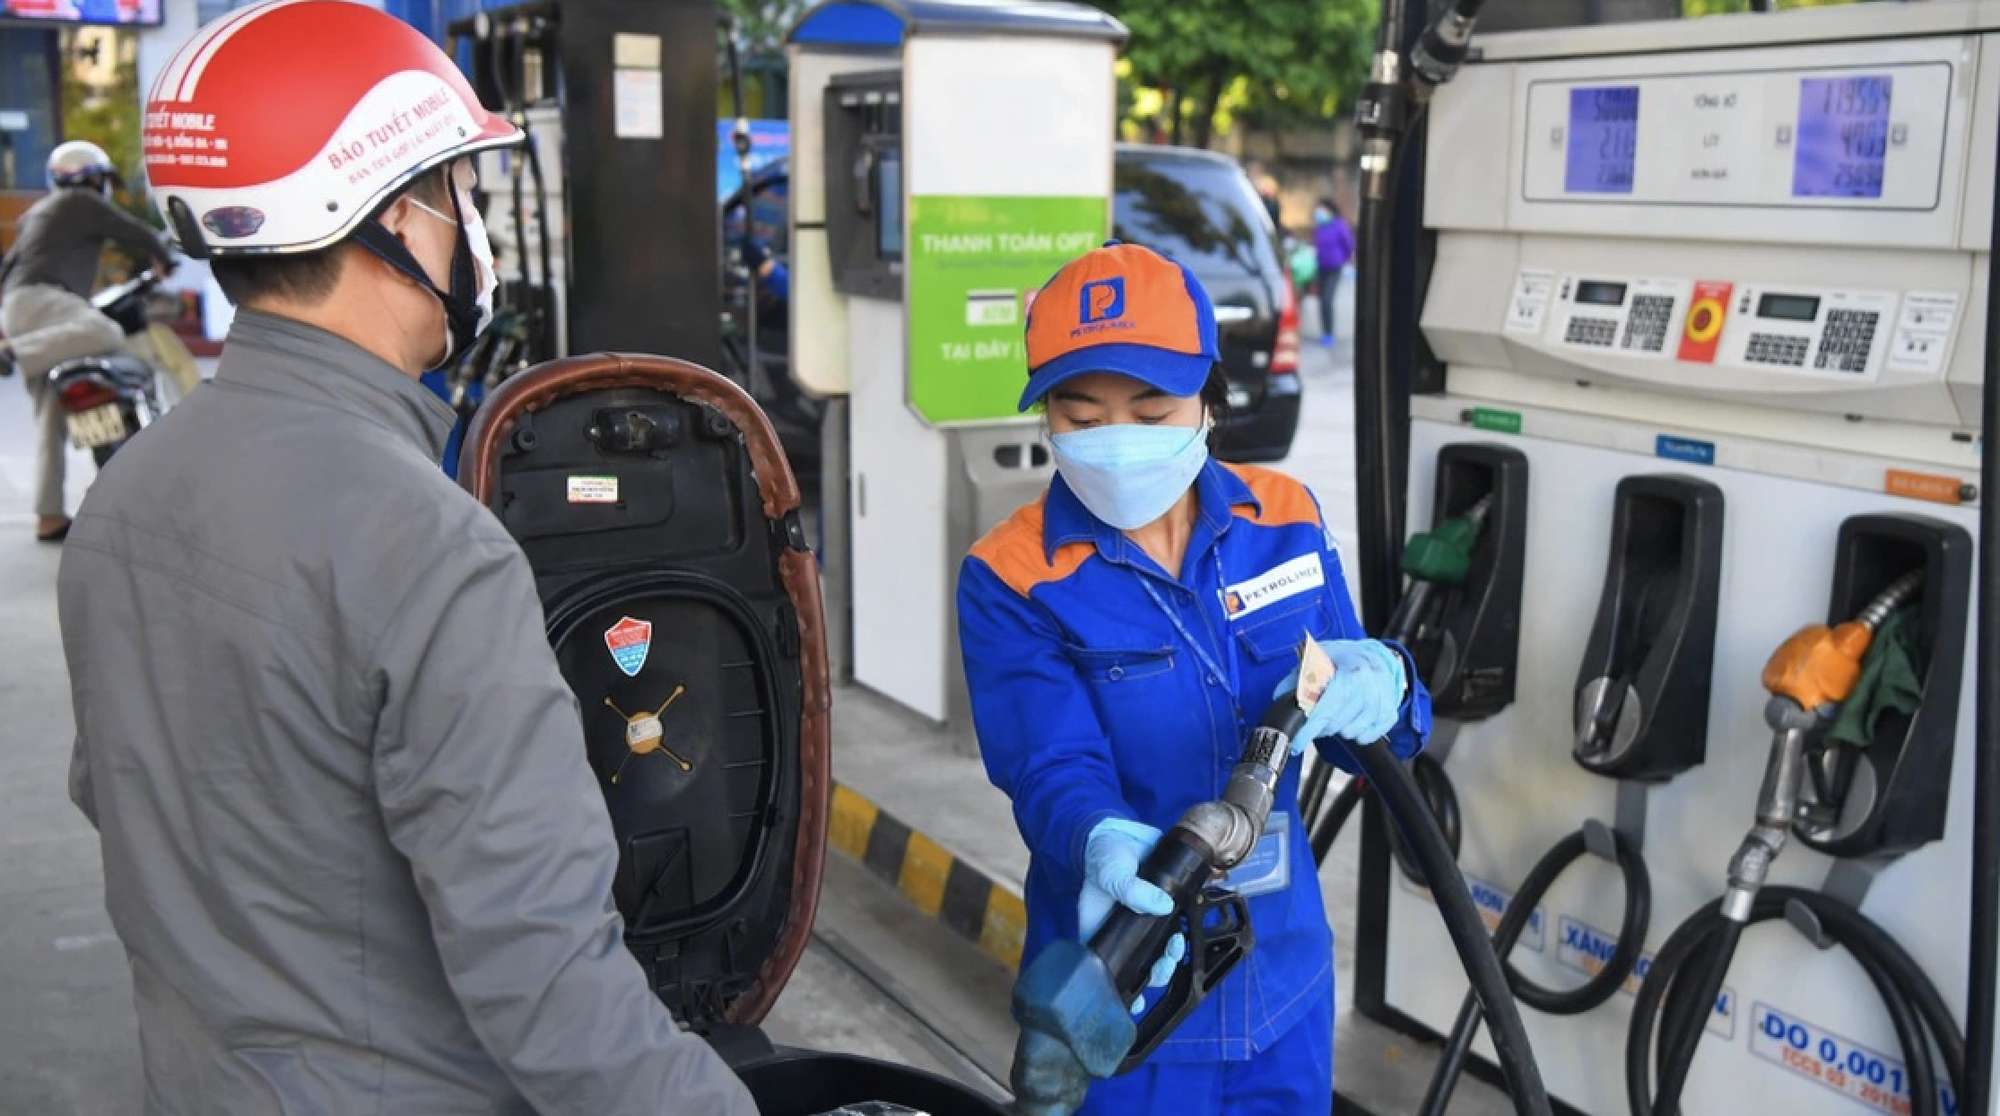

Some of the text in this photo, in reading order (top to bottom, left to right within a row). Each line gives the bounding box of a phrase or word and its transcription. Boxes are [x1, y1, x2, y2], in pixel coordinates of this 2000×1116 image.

[920, 228, 1097, 252] THANH TOÁN OPT
[940, 342, 970, 365] TẠI
[974, 336, 1011, 361] ĐÂY
[1763, 1011, 1810, 1050] DO
